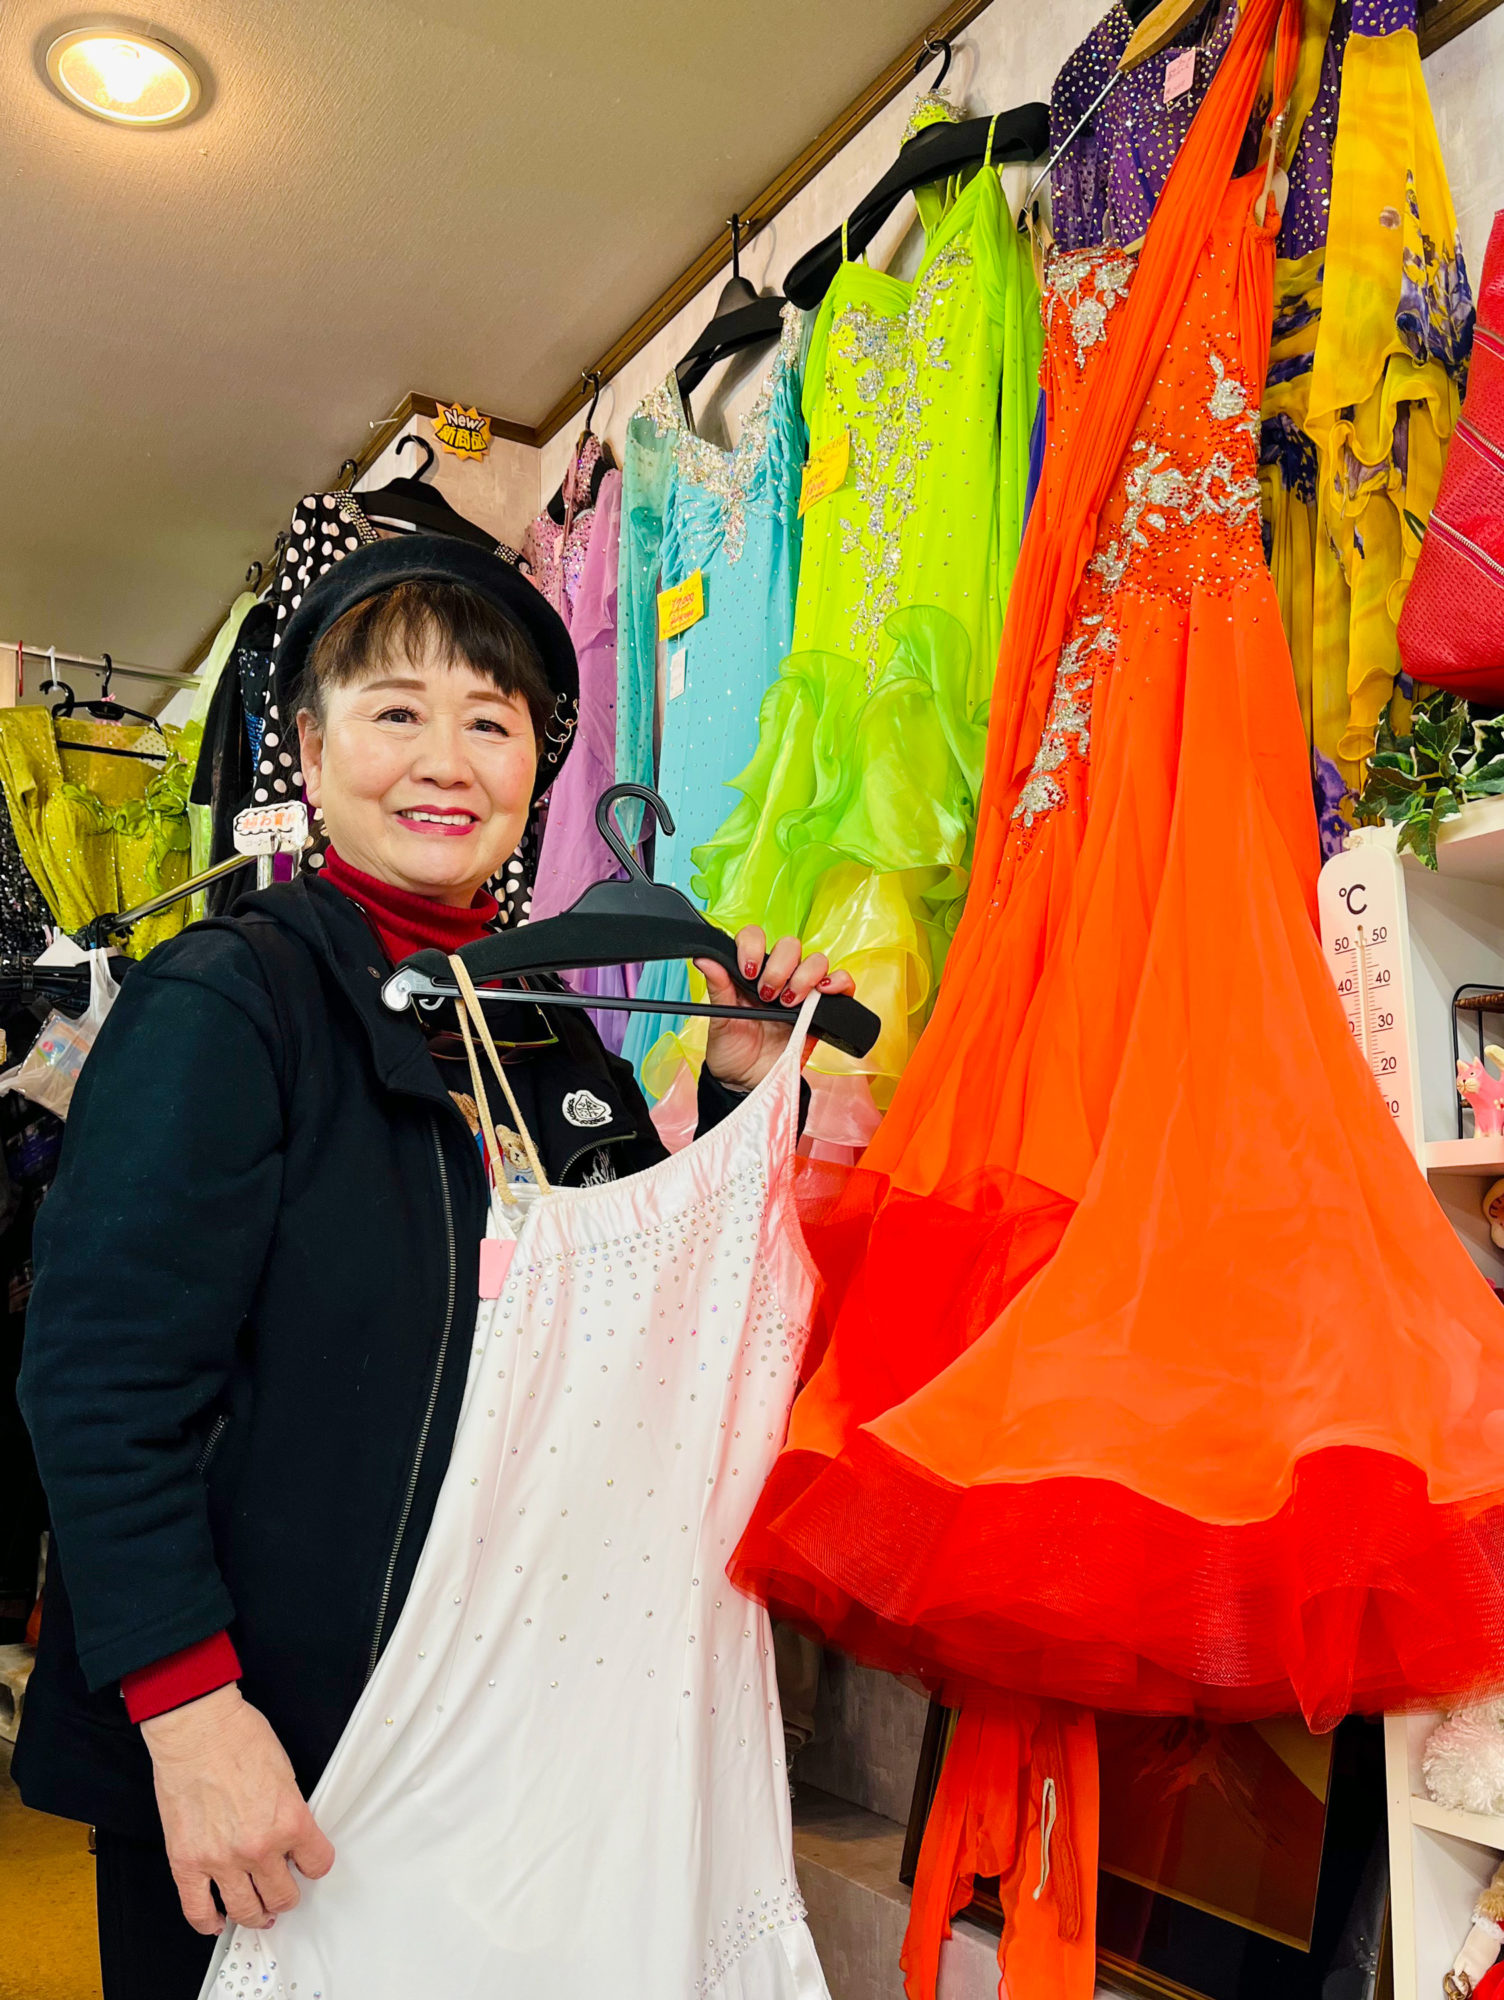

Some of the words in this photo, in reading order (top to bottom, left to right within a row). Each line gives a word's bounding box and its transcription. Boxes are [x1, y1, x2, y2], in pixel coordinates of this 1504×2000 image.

[444, 409, 486, 431] New!
[436, 425, 487, 451] 新商品
[1339, 884, 1367, 915] °C
[1334, 937, 1350, 952] 50
[1372, 926, 1387, 941] 50
[1337, 980, 1353, 993] 40
[1375, 970, 1391, 984] 40
[1378, 1013, 1394, 1028] 30
[1381, 1057, 1397, 1071] 20
